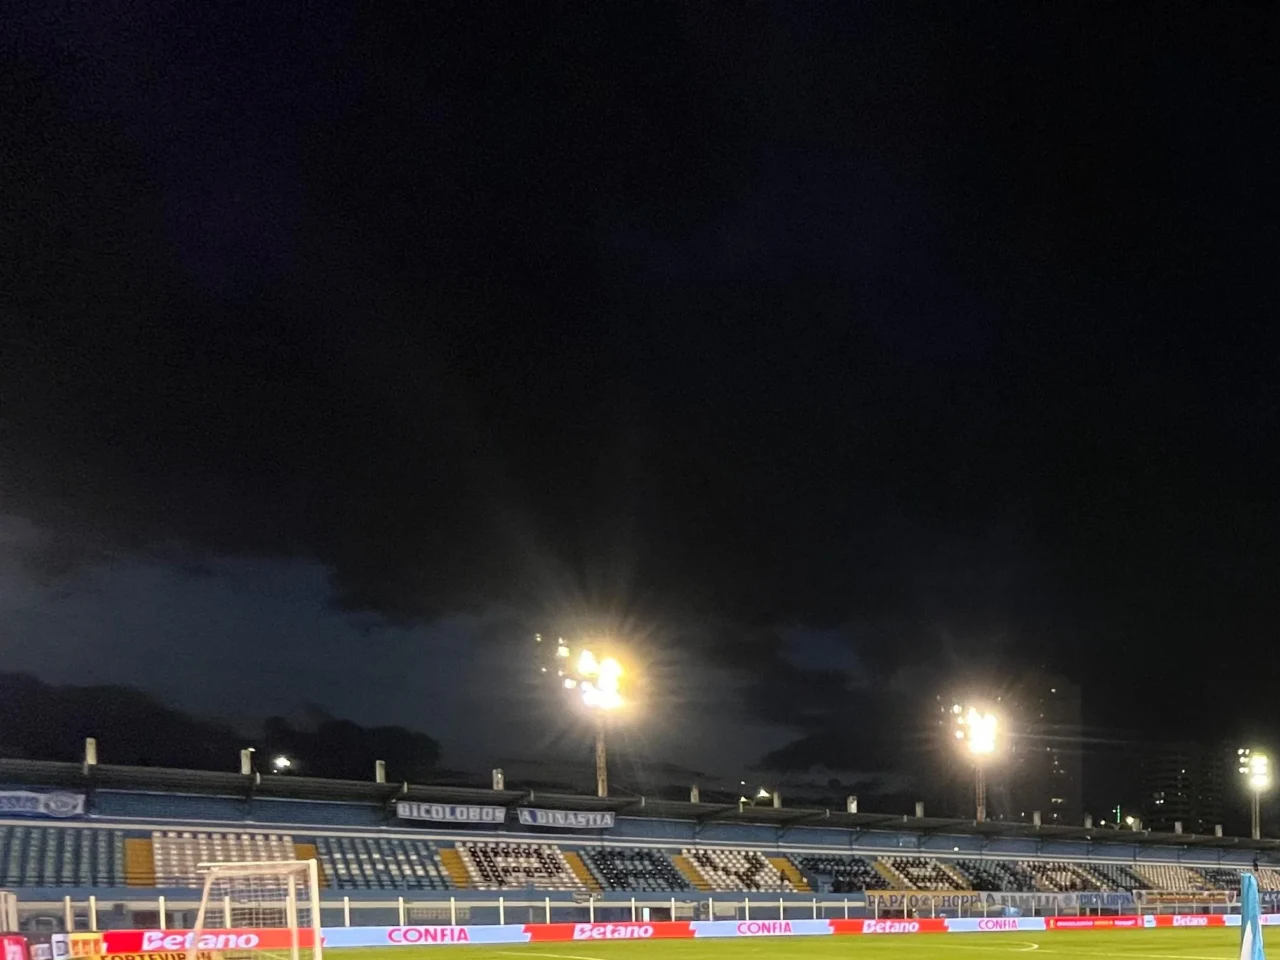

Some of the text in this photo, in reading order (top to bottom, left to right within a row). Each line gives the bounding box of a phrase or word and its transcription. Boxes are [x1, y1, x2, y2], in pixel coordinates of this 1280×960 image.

[737, 922, 792, 934] CONFIA
[862, 920, 919, 933] Betano
[978, 919, 1018, 930] CONFIA
[388, 928, 469, 943] CONFIA
[573, 925, 654, 940] Betano
[142, 931, 259, 951] Betano
